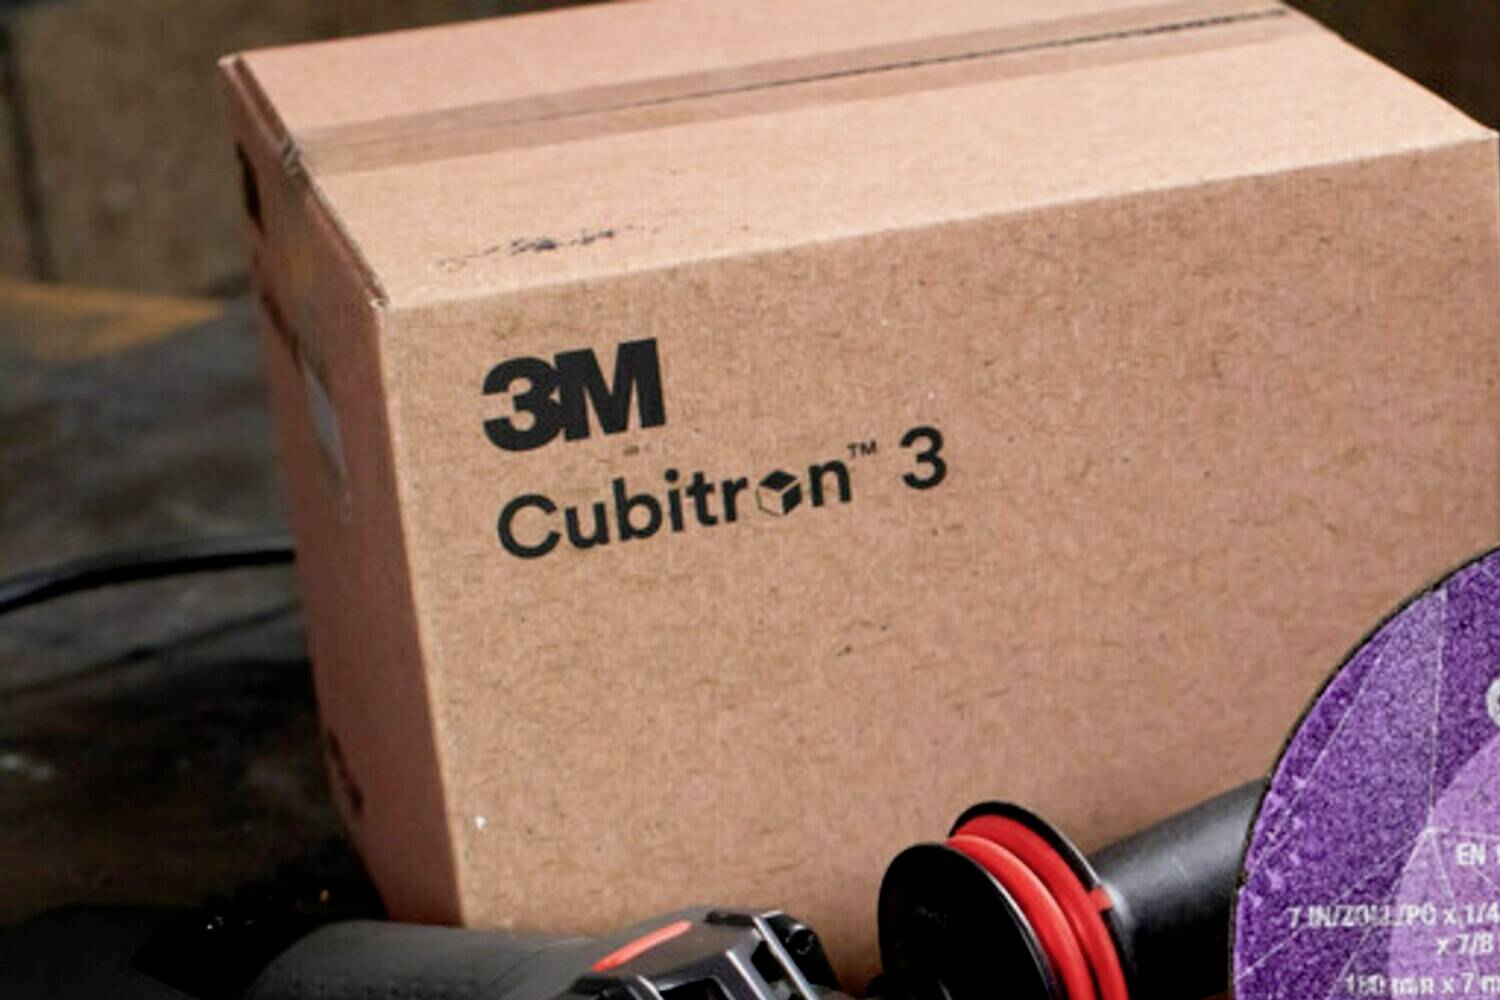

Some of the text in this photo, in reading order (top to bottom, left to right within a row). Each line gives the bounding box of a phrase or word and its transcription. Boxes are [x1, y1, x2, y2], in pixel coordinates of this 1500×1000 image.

[483, 338, 666, 451] 3M
[900, 426, 947, 489] 3
[1456, 844, 1484, 866] EN
